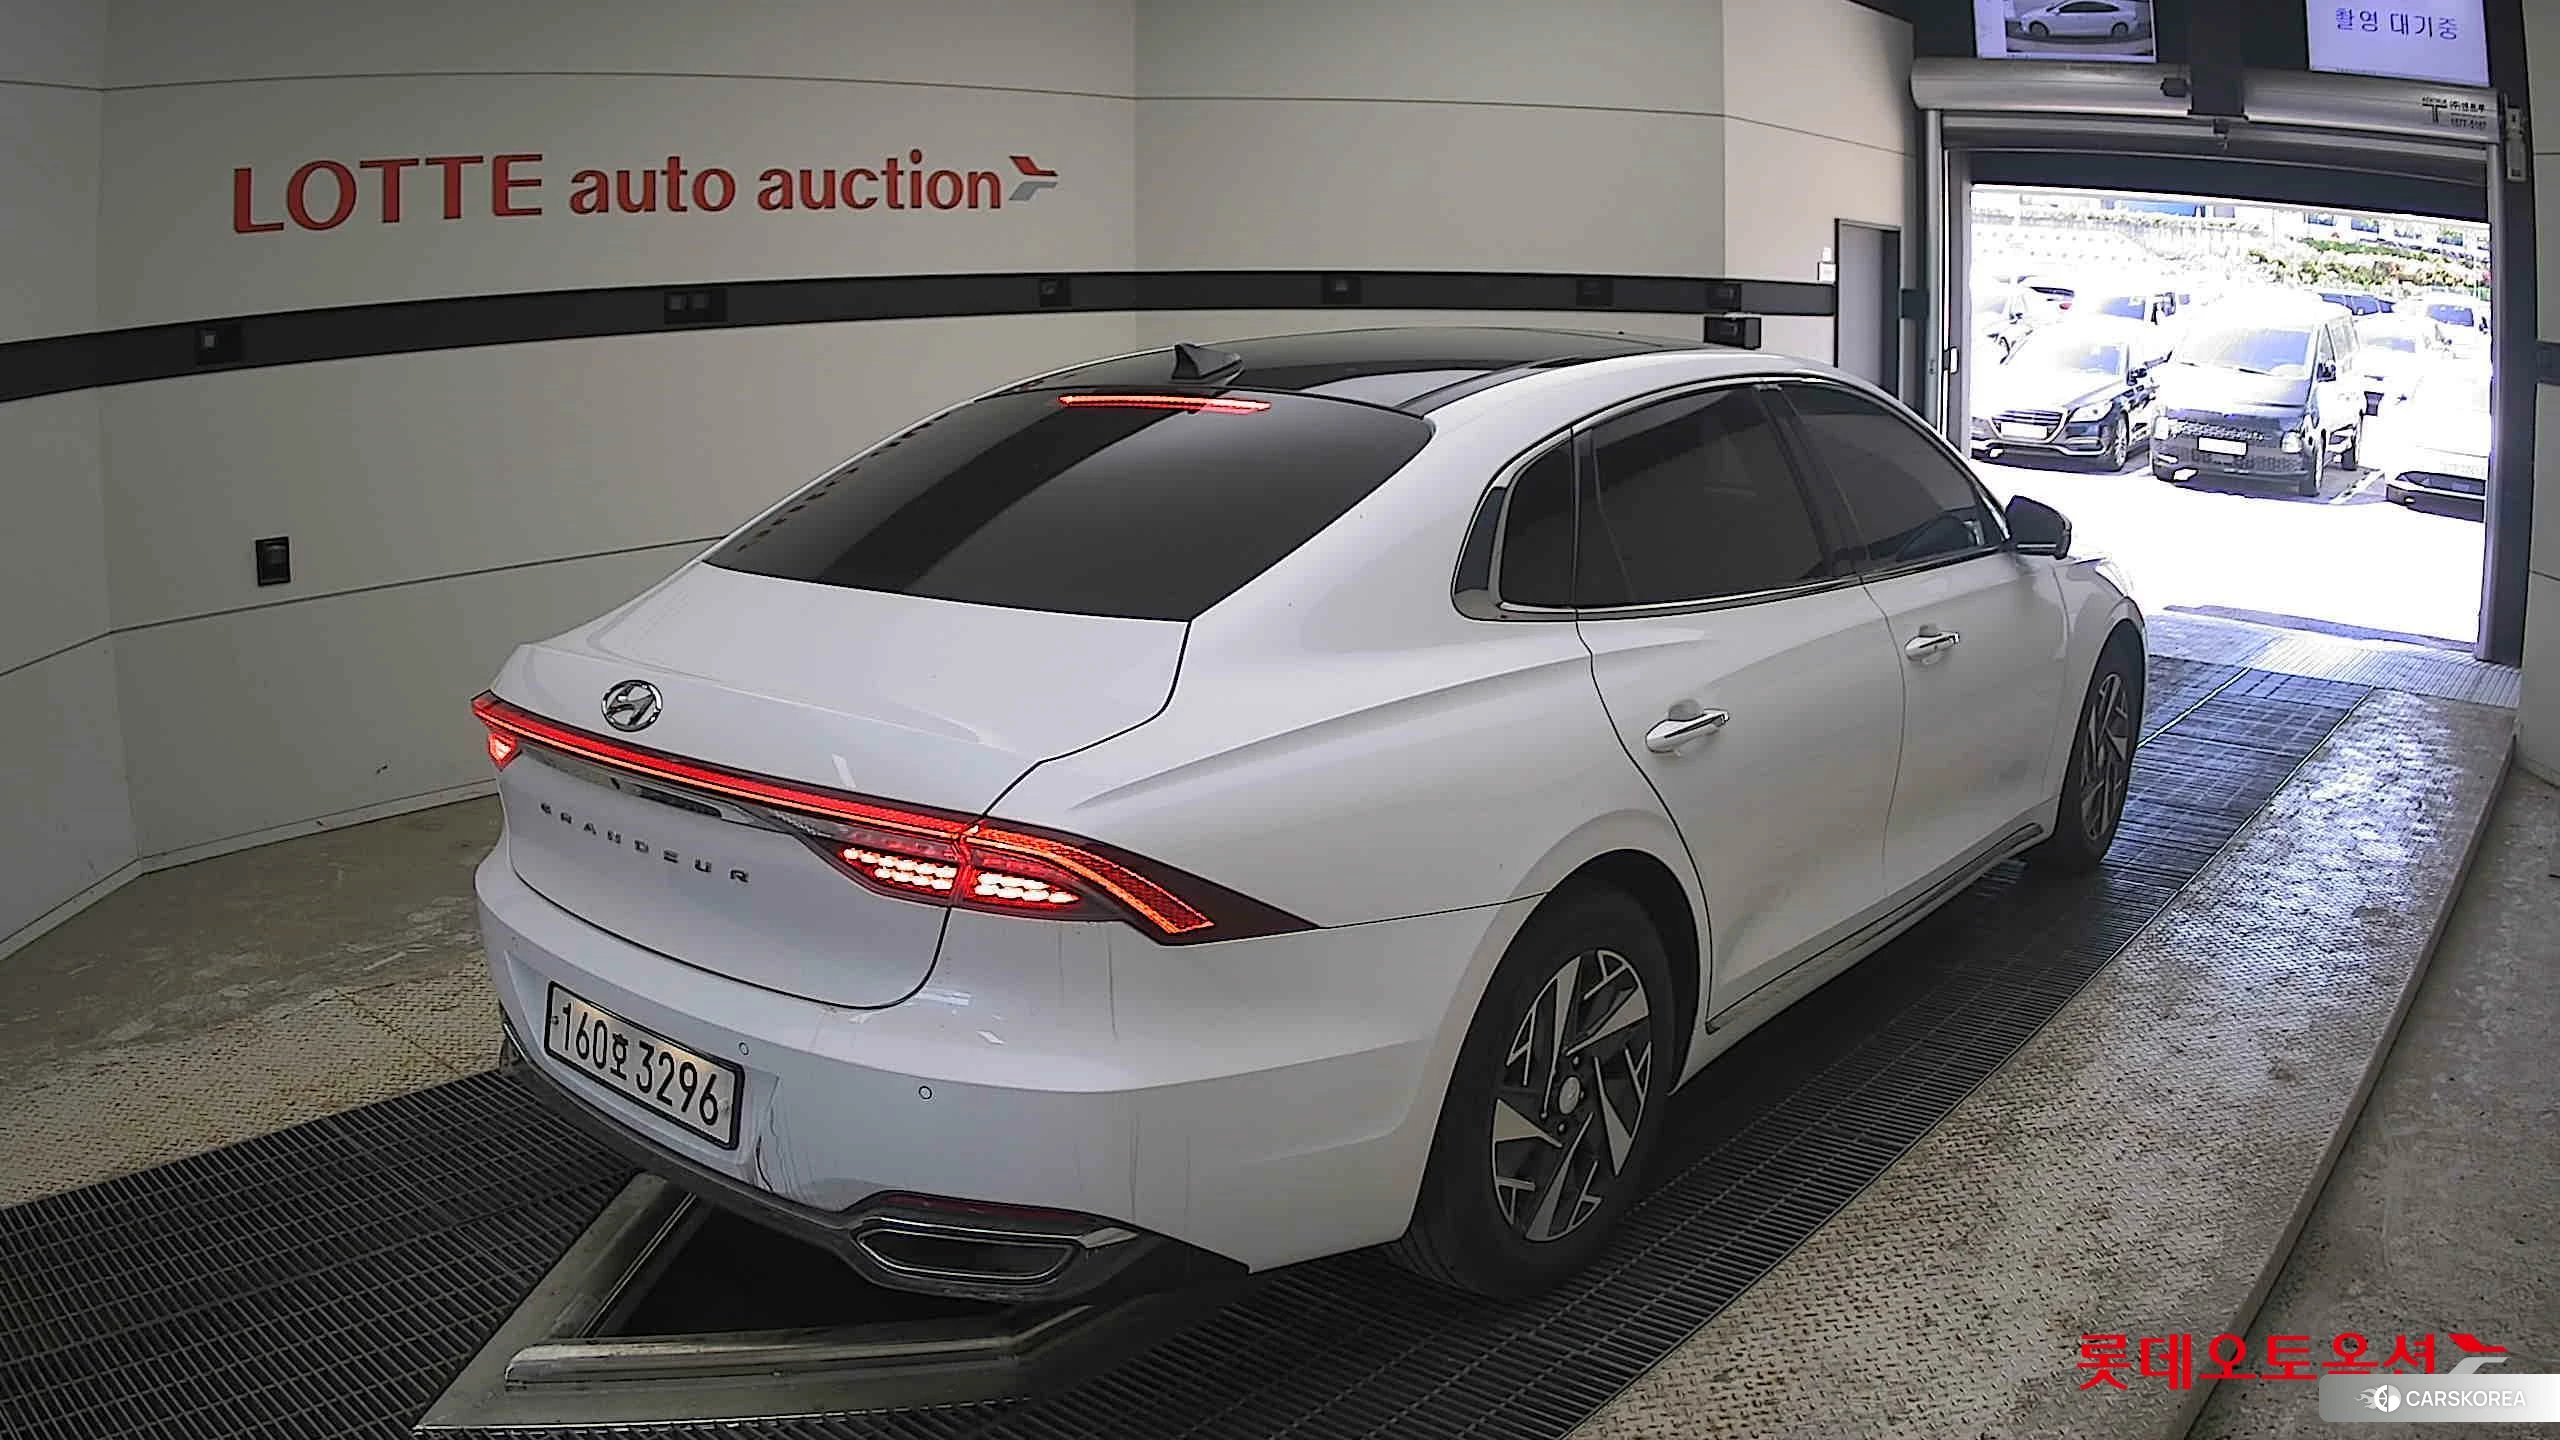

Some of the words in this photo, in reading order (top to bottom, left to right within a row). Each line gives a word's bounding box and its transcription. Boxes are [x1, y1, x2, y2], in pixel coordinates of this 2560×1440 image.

[2336, 8, 2378, 33] 촬영
[2390, 13, 2457, 40] 대기중
[233, 153, 543, 234] LOTTE
[569, 155, 736, 215] auto
[756, 148, 1002, 211] auction
[540, 802, 749, 883] GRANDEUR
